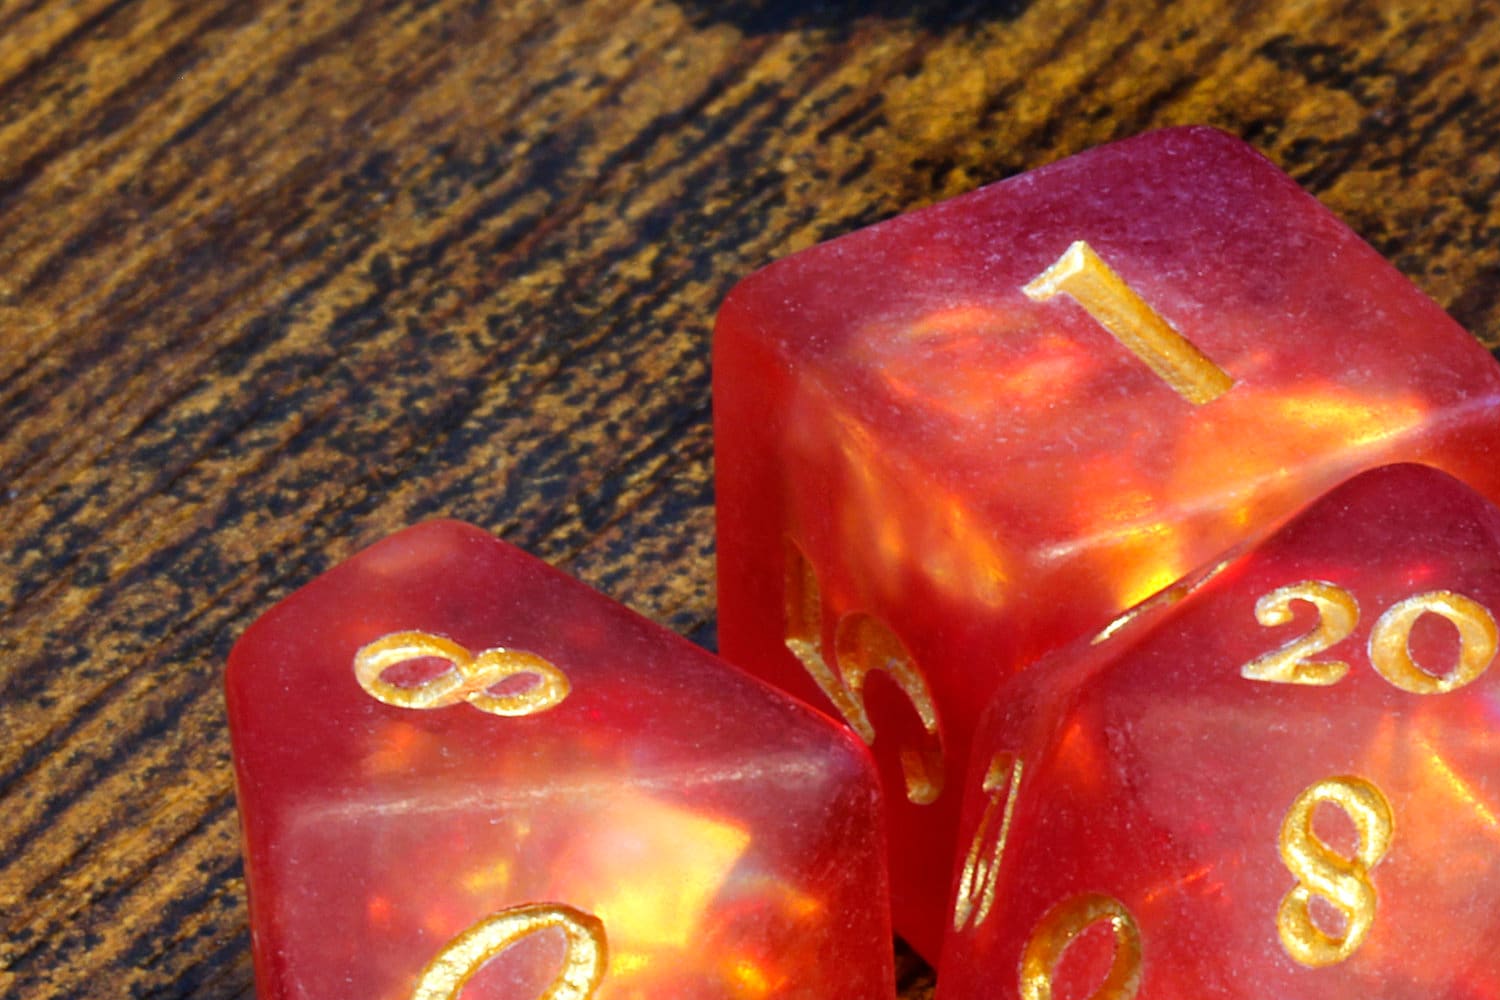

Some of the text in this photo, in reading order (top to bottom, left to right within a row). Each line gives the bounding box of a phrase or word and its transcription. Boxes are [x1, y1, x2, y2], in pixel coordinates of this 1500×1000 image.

[1022, 240, 1236, 405] 1
[354, 631, 571, 717] 8
[1240, 579, 1499, 694] 20
[1278, 774, 1394, 969] 8
